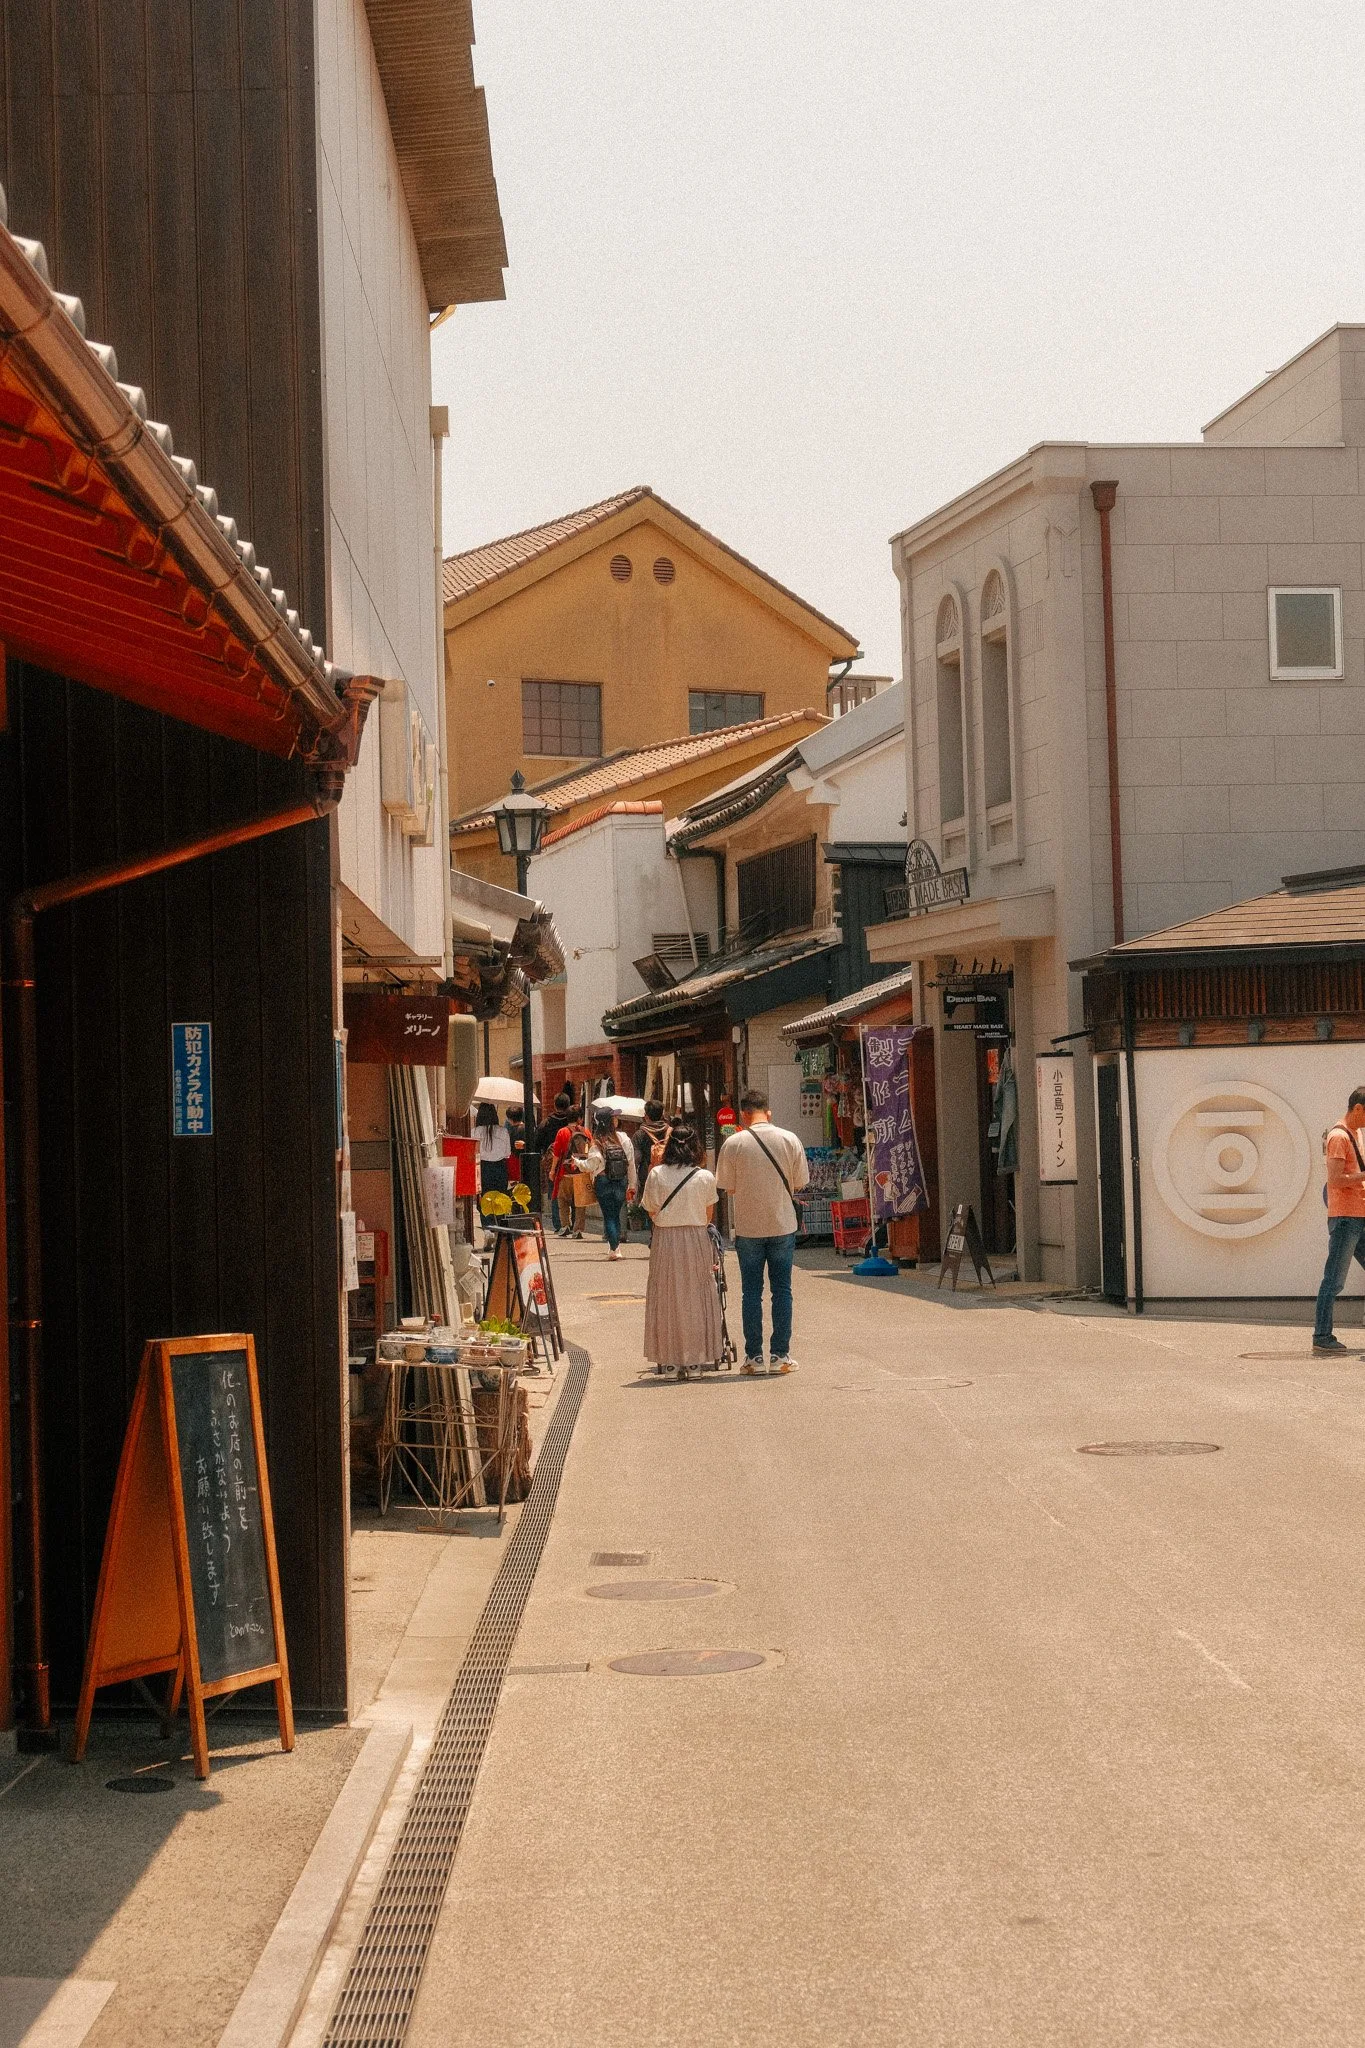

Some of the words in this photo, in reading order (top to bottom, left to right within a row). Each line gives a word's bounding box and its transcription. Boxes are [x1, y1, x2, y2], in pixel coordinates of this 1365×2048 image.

[914, 879, 941, 906] MADE
[942, 872, 965, 898] BASE
[977, 994, 997, 1003] BAR
[404, 1024, 441, 1037] メリーノ
[405, 1013, 433, 1021] ギャラリー
[184, 1026, 204, 1133] 防犯カメラ作動中
[867, 1036, 897, 1144] 製作所
[1052, 1069, 1066, 1168] 小豆島ラーメン
